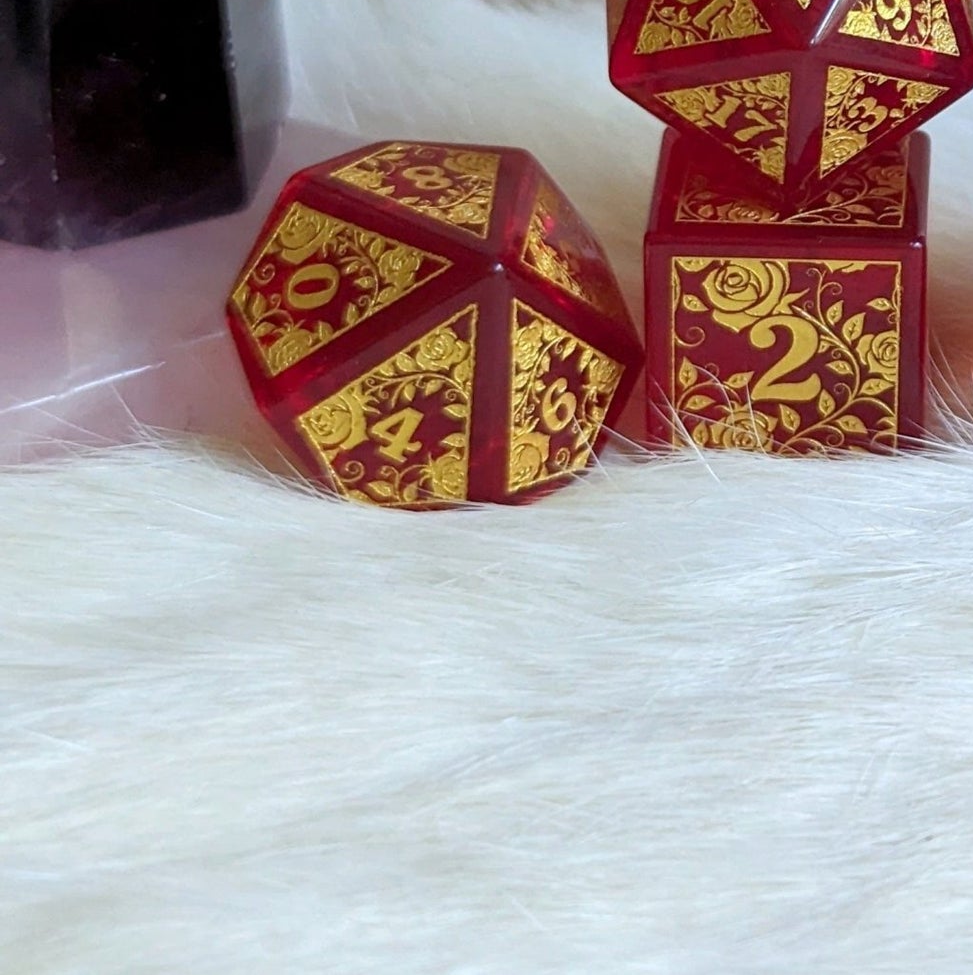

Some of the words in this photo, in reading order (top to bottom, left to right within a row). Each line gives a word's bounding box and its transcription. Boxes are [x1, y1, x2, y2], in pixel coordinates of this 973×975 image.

[705, 96, 776, 142] 17
[848, 97, 888, 134] 3
[403, 165, 454, 190] 8
[286, 263, 340, 310] 0
[751, 315, 823, 401] 2
[541, 377, 577, 433] 6
[372, 407, 424, 462] 4
